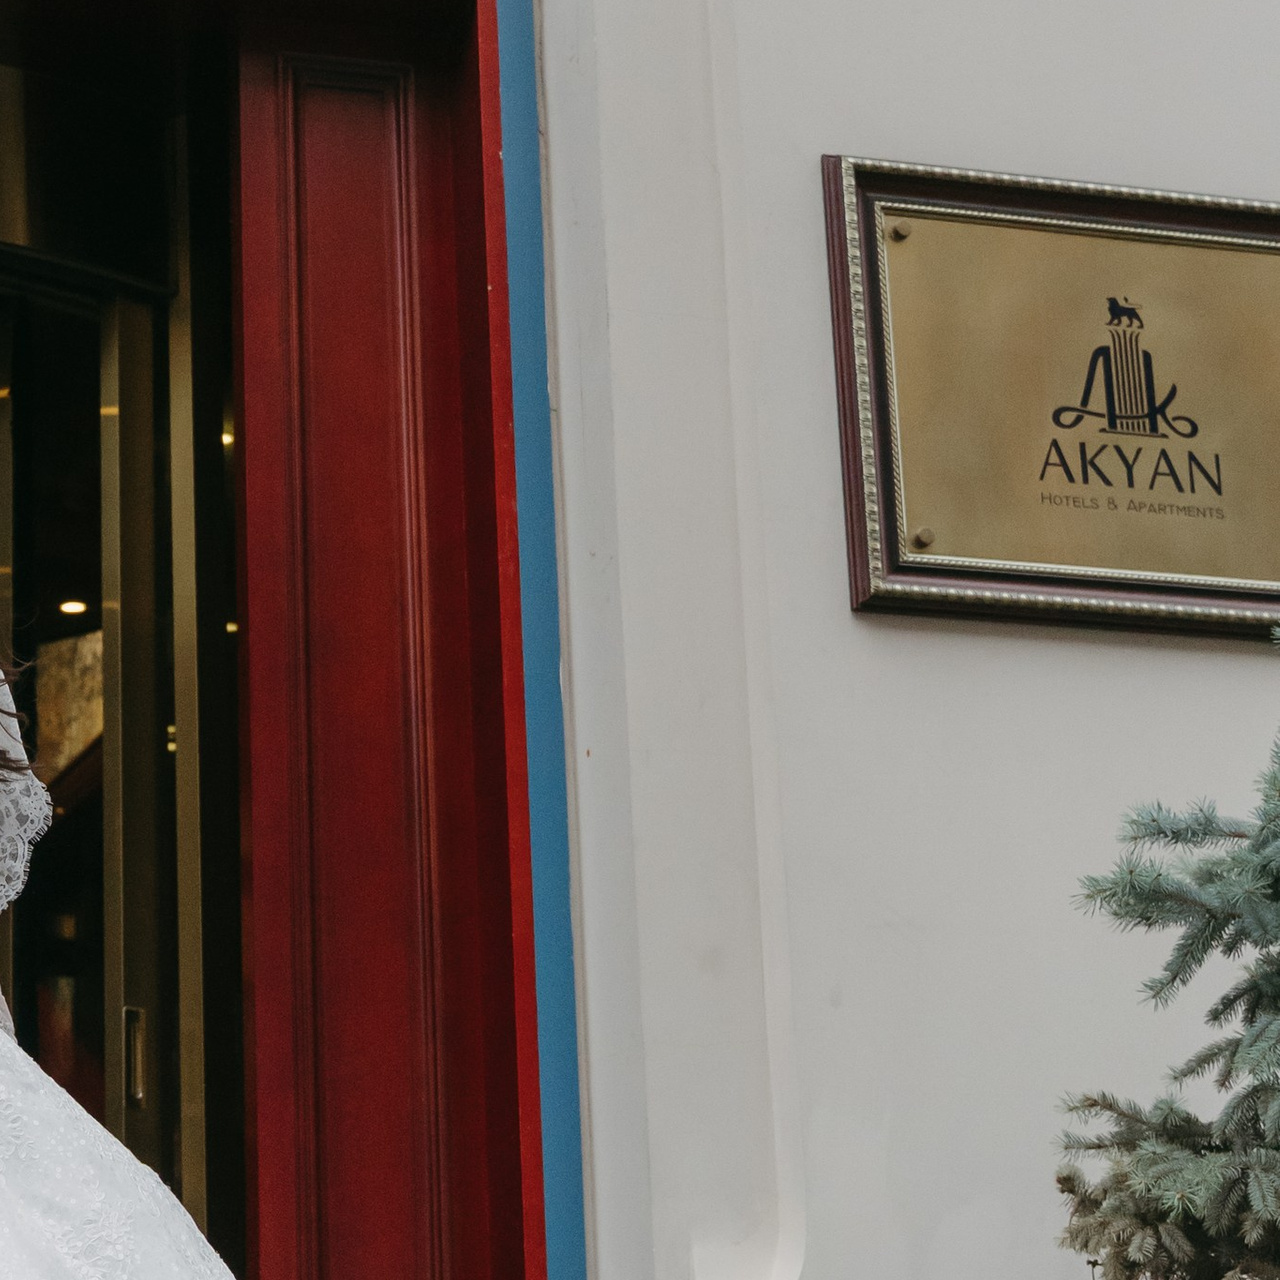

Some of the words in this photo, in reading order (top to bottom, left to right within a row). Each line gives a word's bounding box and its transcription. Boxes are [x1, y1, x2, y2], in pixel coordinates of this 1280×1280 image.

[1039, 438, 1223, 496] AKYAN
[1040, 491, 1099, 510] HOTELS
[1107, 498, 1119, 511] &
[1126, 498, 1225, 520] APARTMENTS
